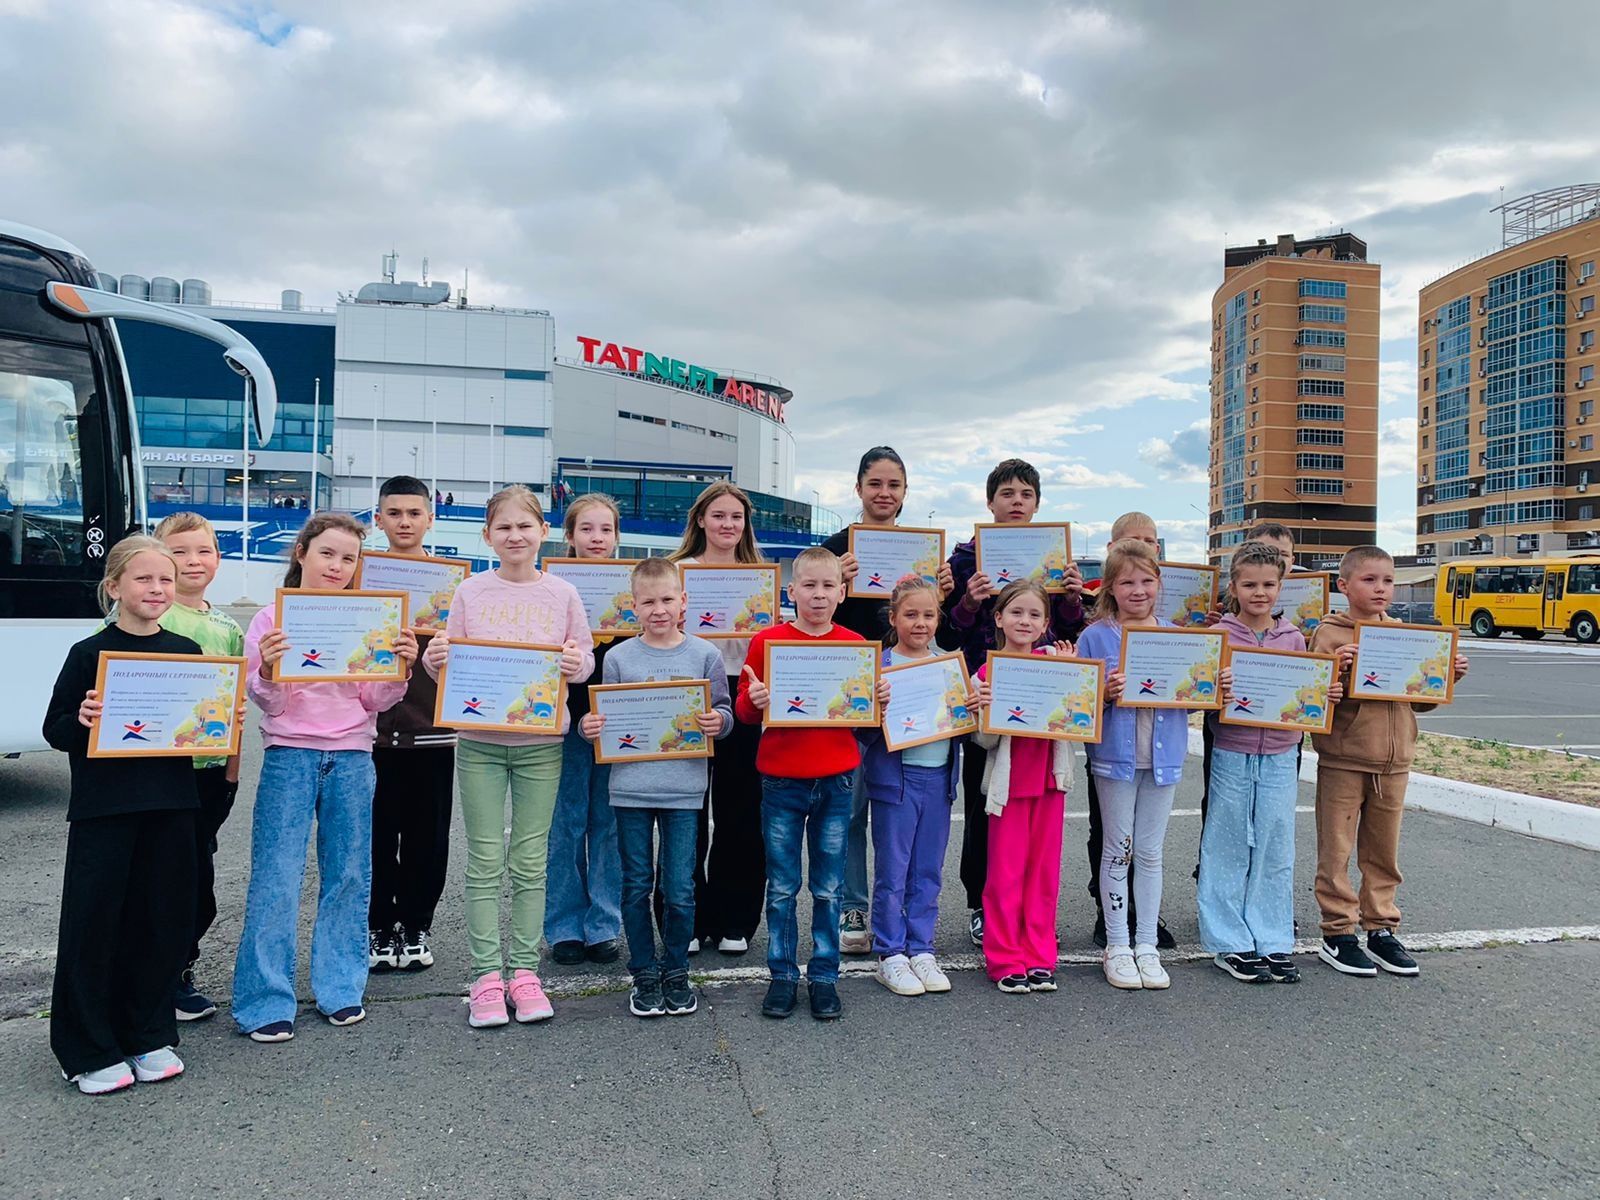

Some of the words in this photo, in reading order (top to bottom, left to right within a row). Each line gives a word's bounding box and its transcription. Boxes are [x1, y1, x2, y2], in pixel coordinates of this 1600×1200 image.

[724, 376, 785, 424] ARENA
[165, 452, 187, 462] АК
[191, 453, 235, 463] БАРС
[1495, 594, 1515, 604] ДЕТИ
[479, 601, 554, 635] HAPPY
